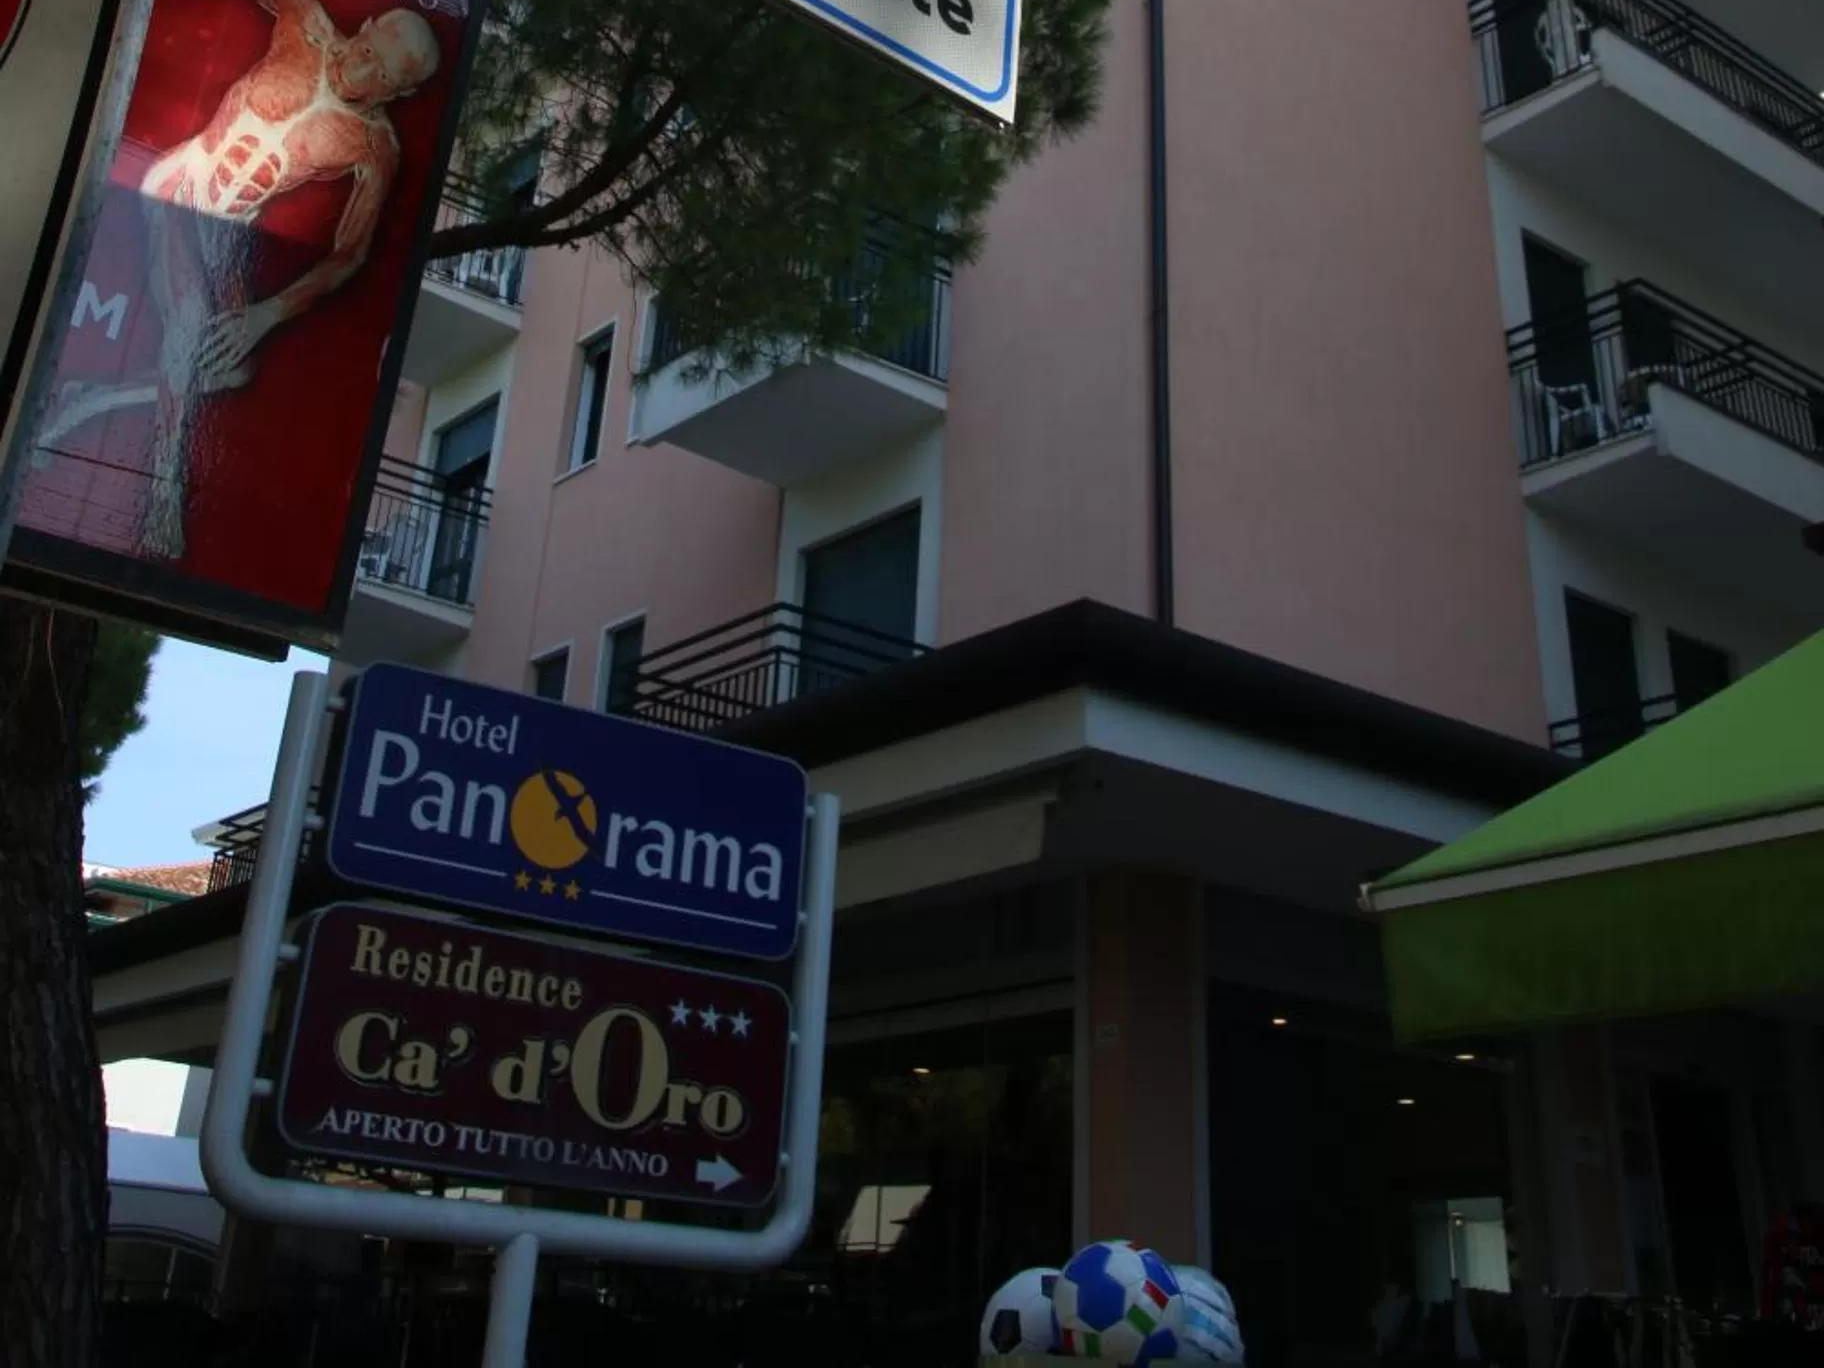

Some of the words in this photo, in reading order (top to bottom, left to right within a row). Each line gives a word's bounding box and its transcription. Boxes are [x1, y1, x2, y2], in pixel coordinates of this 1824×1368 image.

[419, 693, 520, 756] Hotel
[350, 924, 584, 1010] Residence
[335, 1010, 474, 1090] Ca'
[492, 1006, 746, 1134] d'Oro
[317, 1106, 447, 1148] APERTO
[452, 1121, 557, 1164] TUTTO
[561, 1141, 671, 1178] L'ANNO
